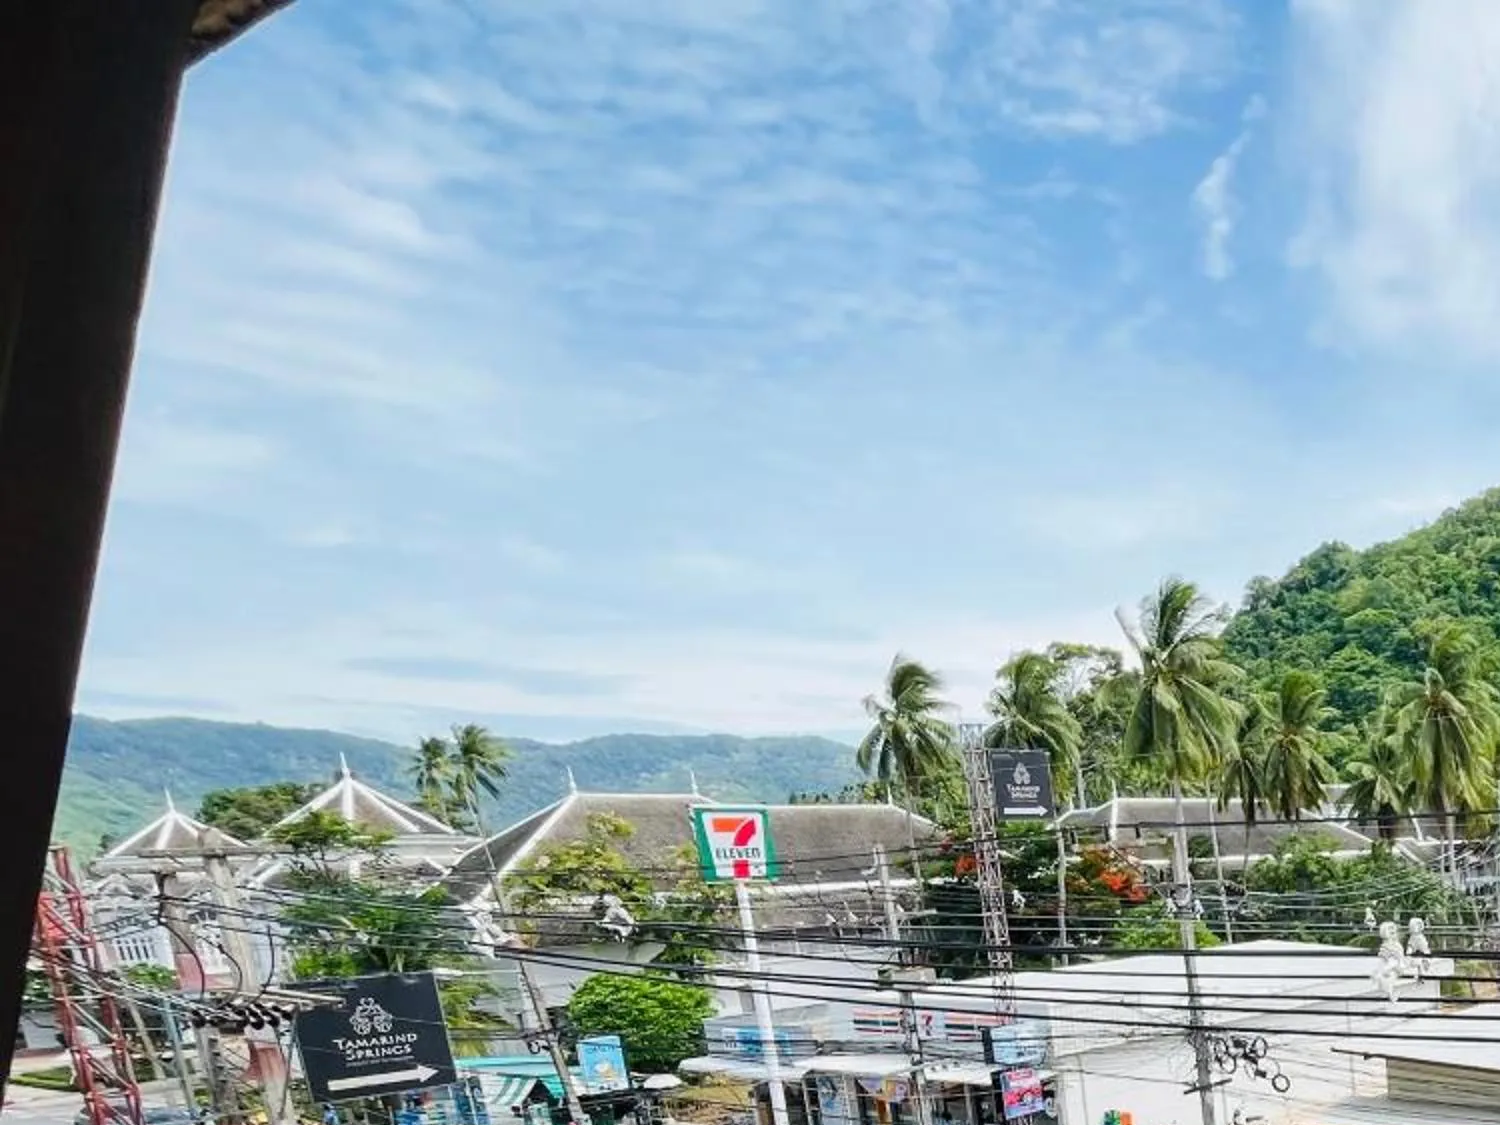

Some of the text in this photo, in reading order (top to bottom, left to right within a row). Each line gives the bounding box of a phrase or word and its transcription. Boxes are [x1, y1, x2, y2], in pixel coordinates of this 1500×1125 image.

[712, 817, 757, 878] 7
[332, 1033, 418, 1050] TAMARIND
[345, 1043, 412, 1061] SPRINGS
